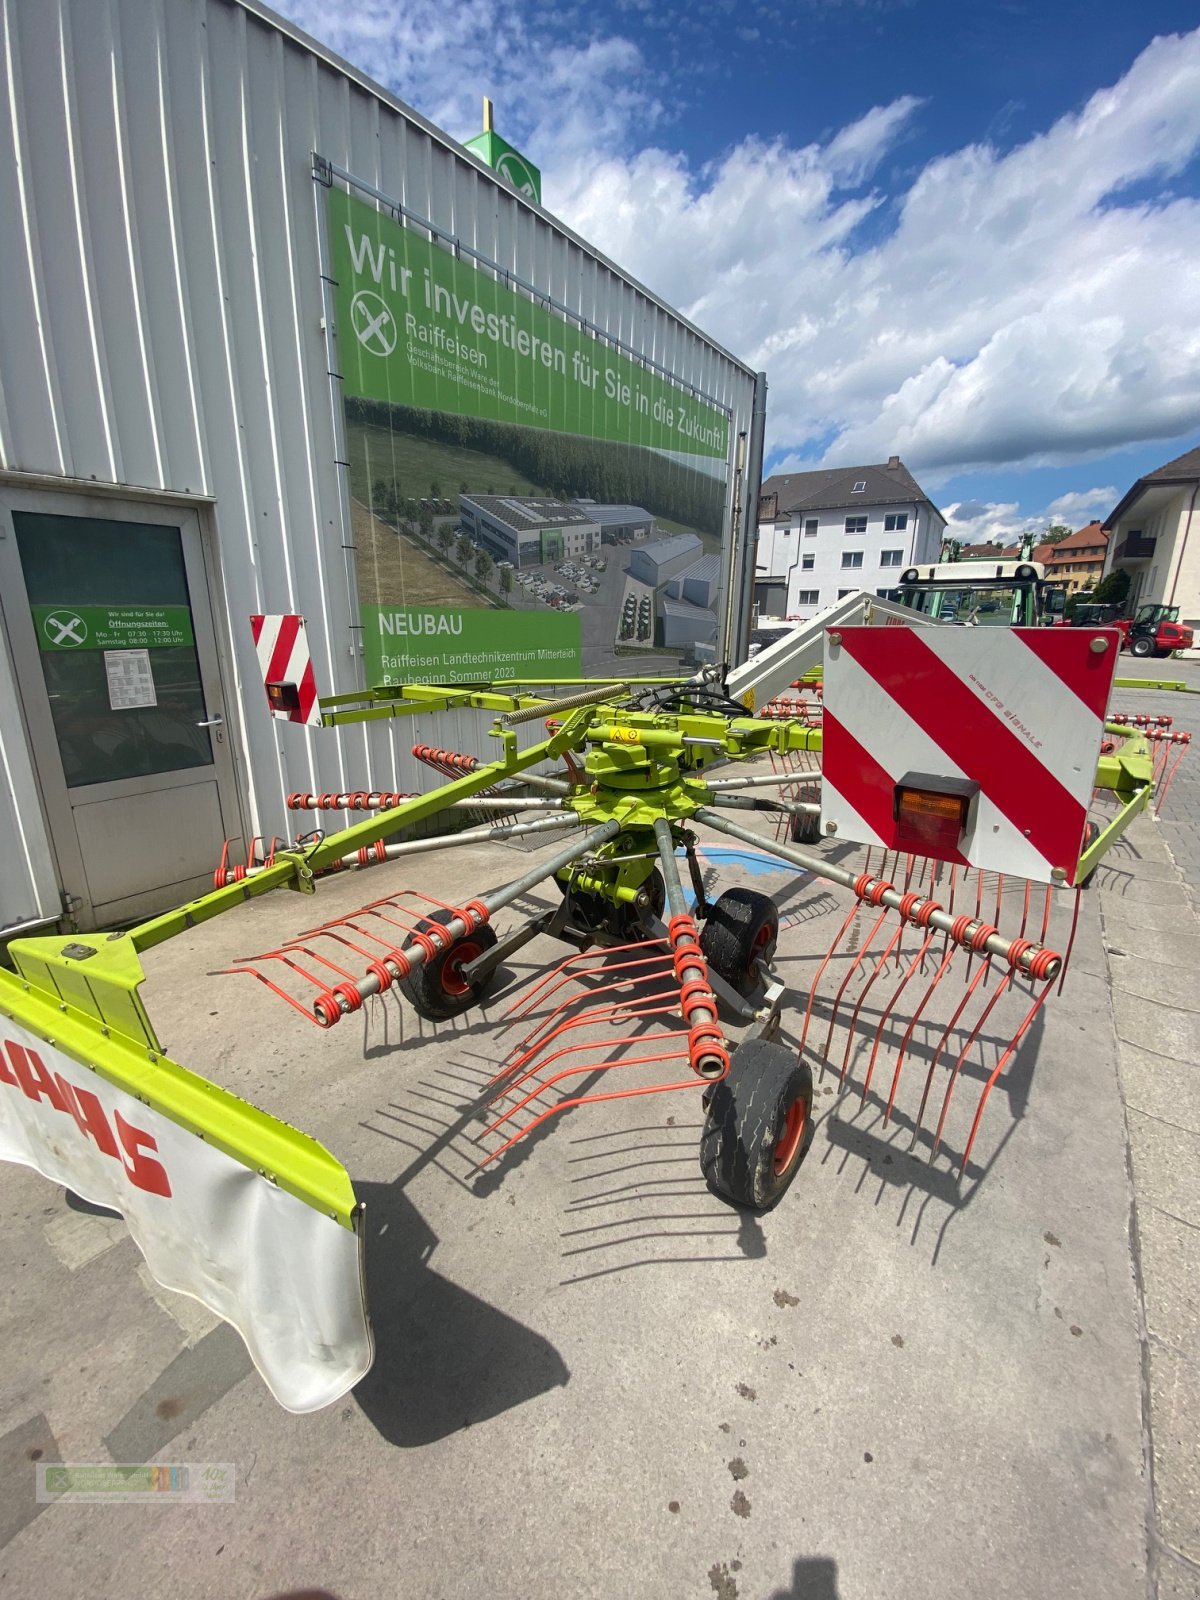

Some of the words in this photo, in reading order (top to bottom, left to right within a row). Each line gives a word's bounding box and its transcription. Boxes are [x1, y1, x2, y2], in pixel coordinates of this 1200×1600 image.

[344, 224, 412, 297] Wir
[424, 267, 566, 375] investieren
[572, 350, 599, 390] für
[604, 368, 631, 406] Sie
[635, 384, 649, 416] in
[653, 397, 674, 427] die
[677, 407, 724, 450] Zukunft!
[405, 312, 488, 369] Raiffeisen
[406, 342, 470, 376] Geschäftsbereich
[470, 368, 488, 383] Ware
[406, 353, 446, 377] Volksbank
[447, 370, 496, 397] Raiffeisenbank
[378, 613, 463, 635] NEUBAU
[381, 653, 440, 668] Raiffeisen
[442, 651, 536, 665] Landtechnikzentrum
[537, 648, 576, 660] Mitterteich
[383, 672, 447, 686] Baubeginn
[449, 670, 491, 682] Sommer
[494, 667, 515, 679] 2023
